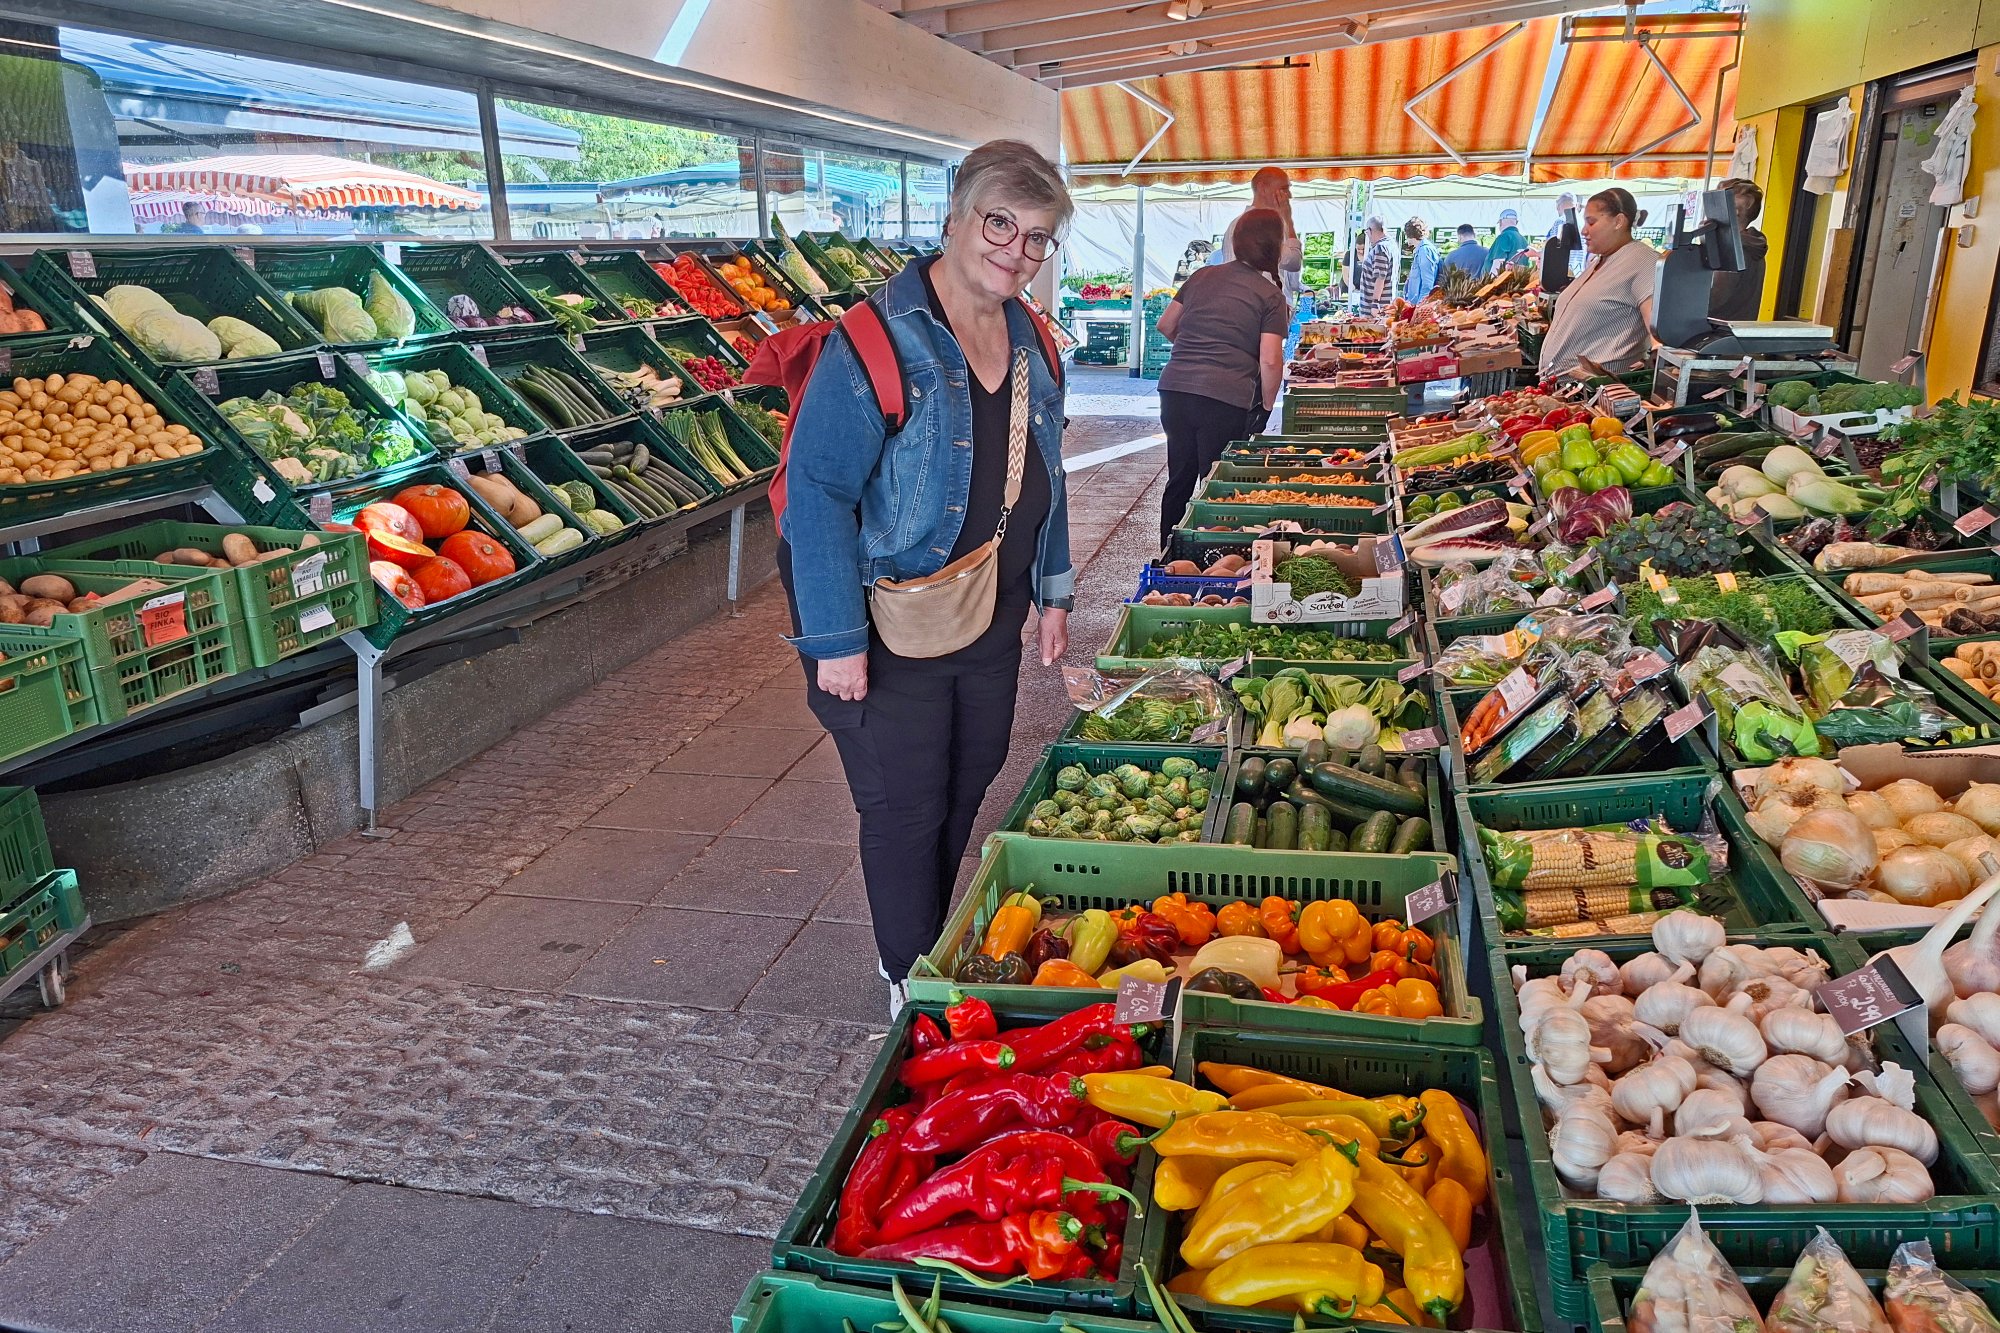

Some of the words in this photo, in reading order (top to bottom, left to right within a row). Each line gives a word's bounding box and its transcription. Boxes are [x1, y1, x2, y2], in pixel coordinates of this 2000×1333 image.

[155, 610, 170, 620] BIO
[150, 617, 175, 629] FINKA
[1573, 887, 1592, 919] mais
